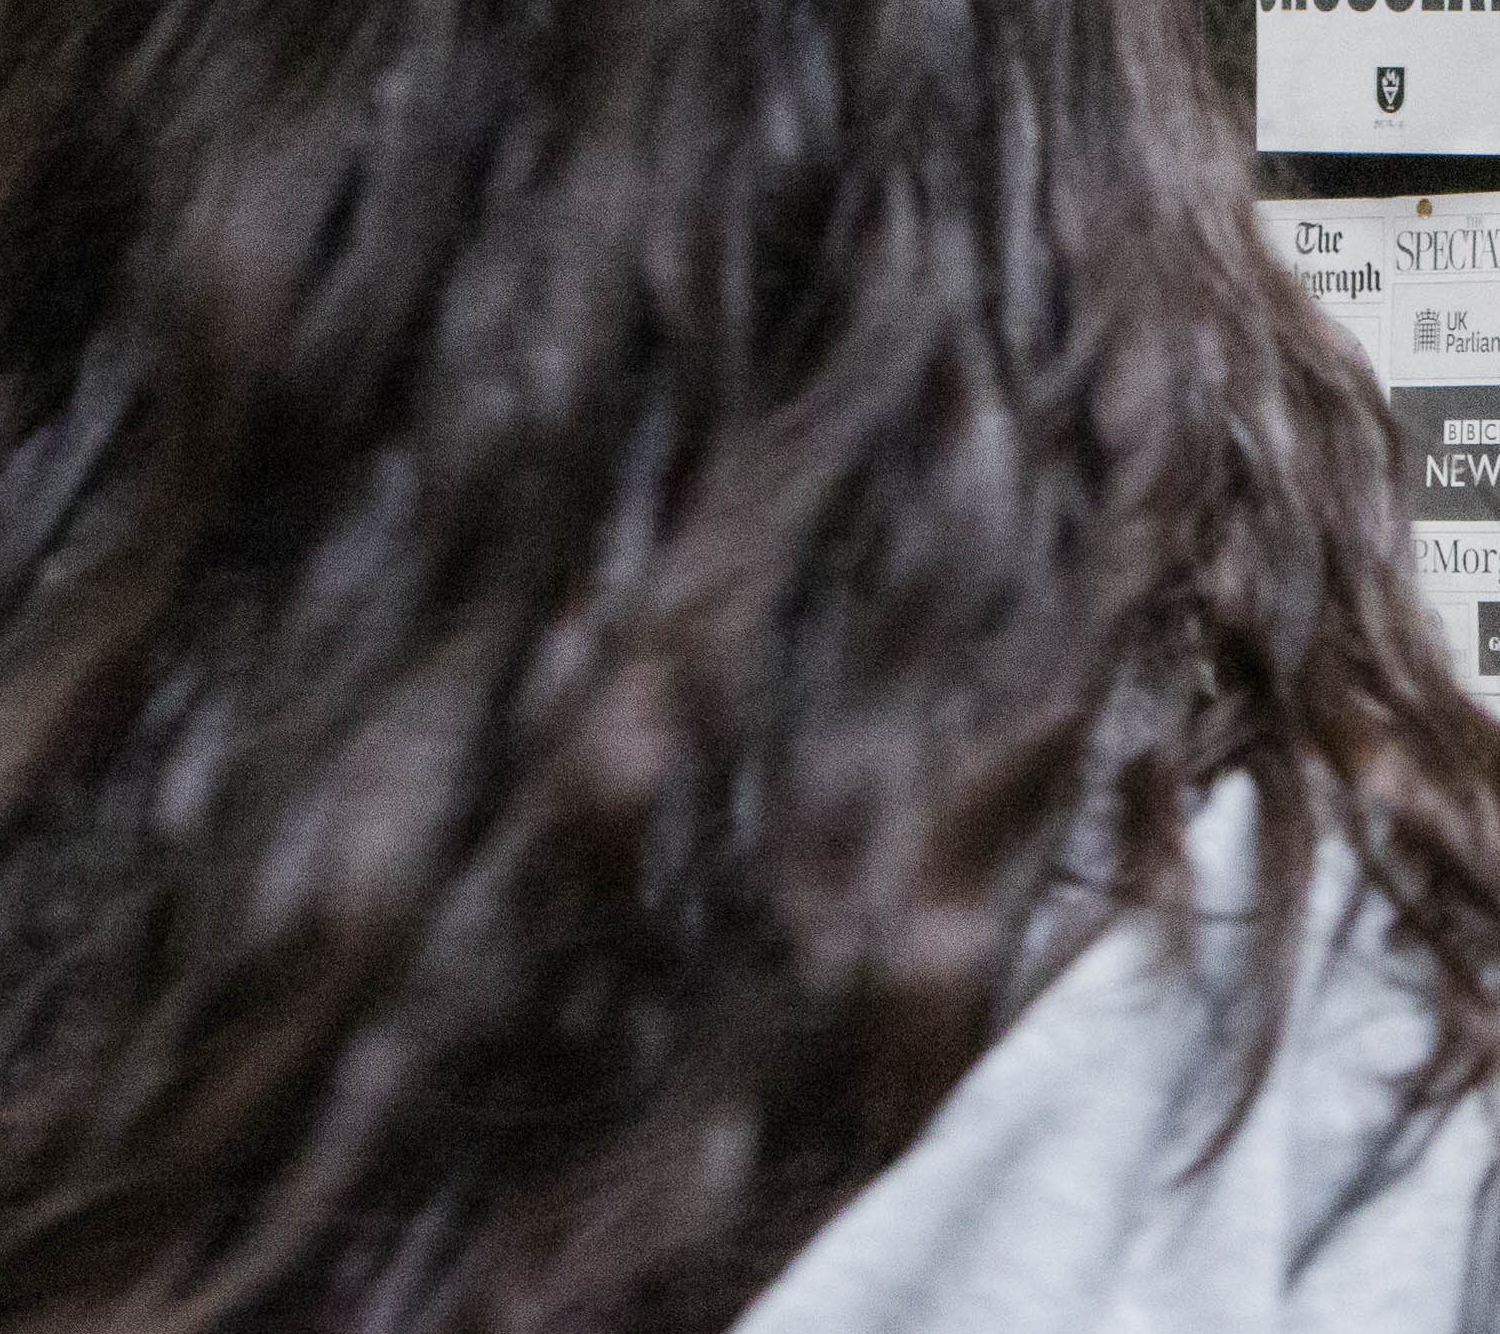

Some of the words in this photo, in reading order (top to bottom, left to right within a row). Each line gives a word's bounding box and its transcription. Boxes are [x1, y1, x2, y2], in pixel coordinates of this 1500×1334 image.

[1295, 221, 1343, 255] The
[1295, 261, 1382, 299] egraph
[1447, 311, 1468, 331] UK
[1447, 422, 1499, 443] BBC
